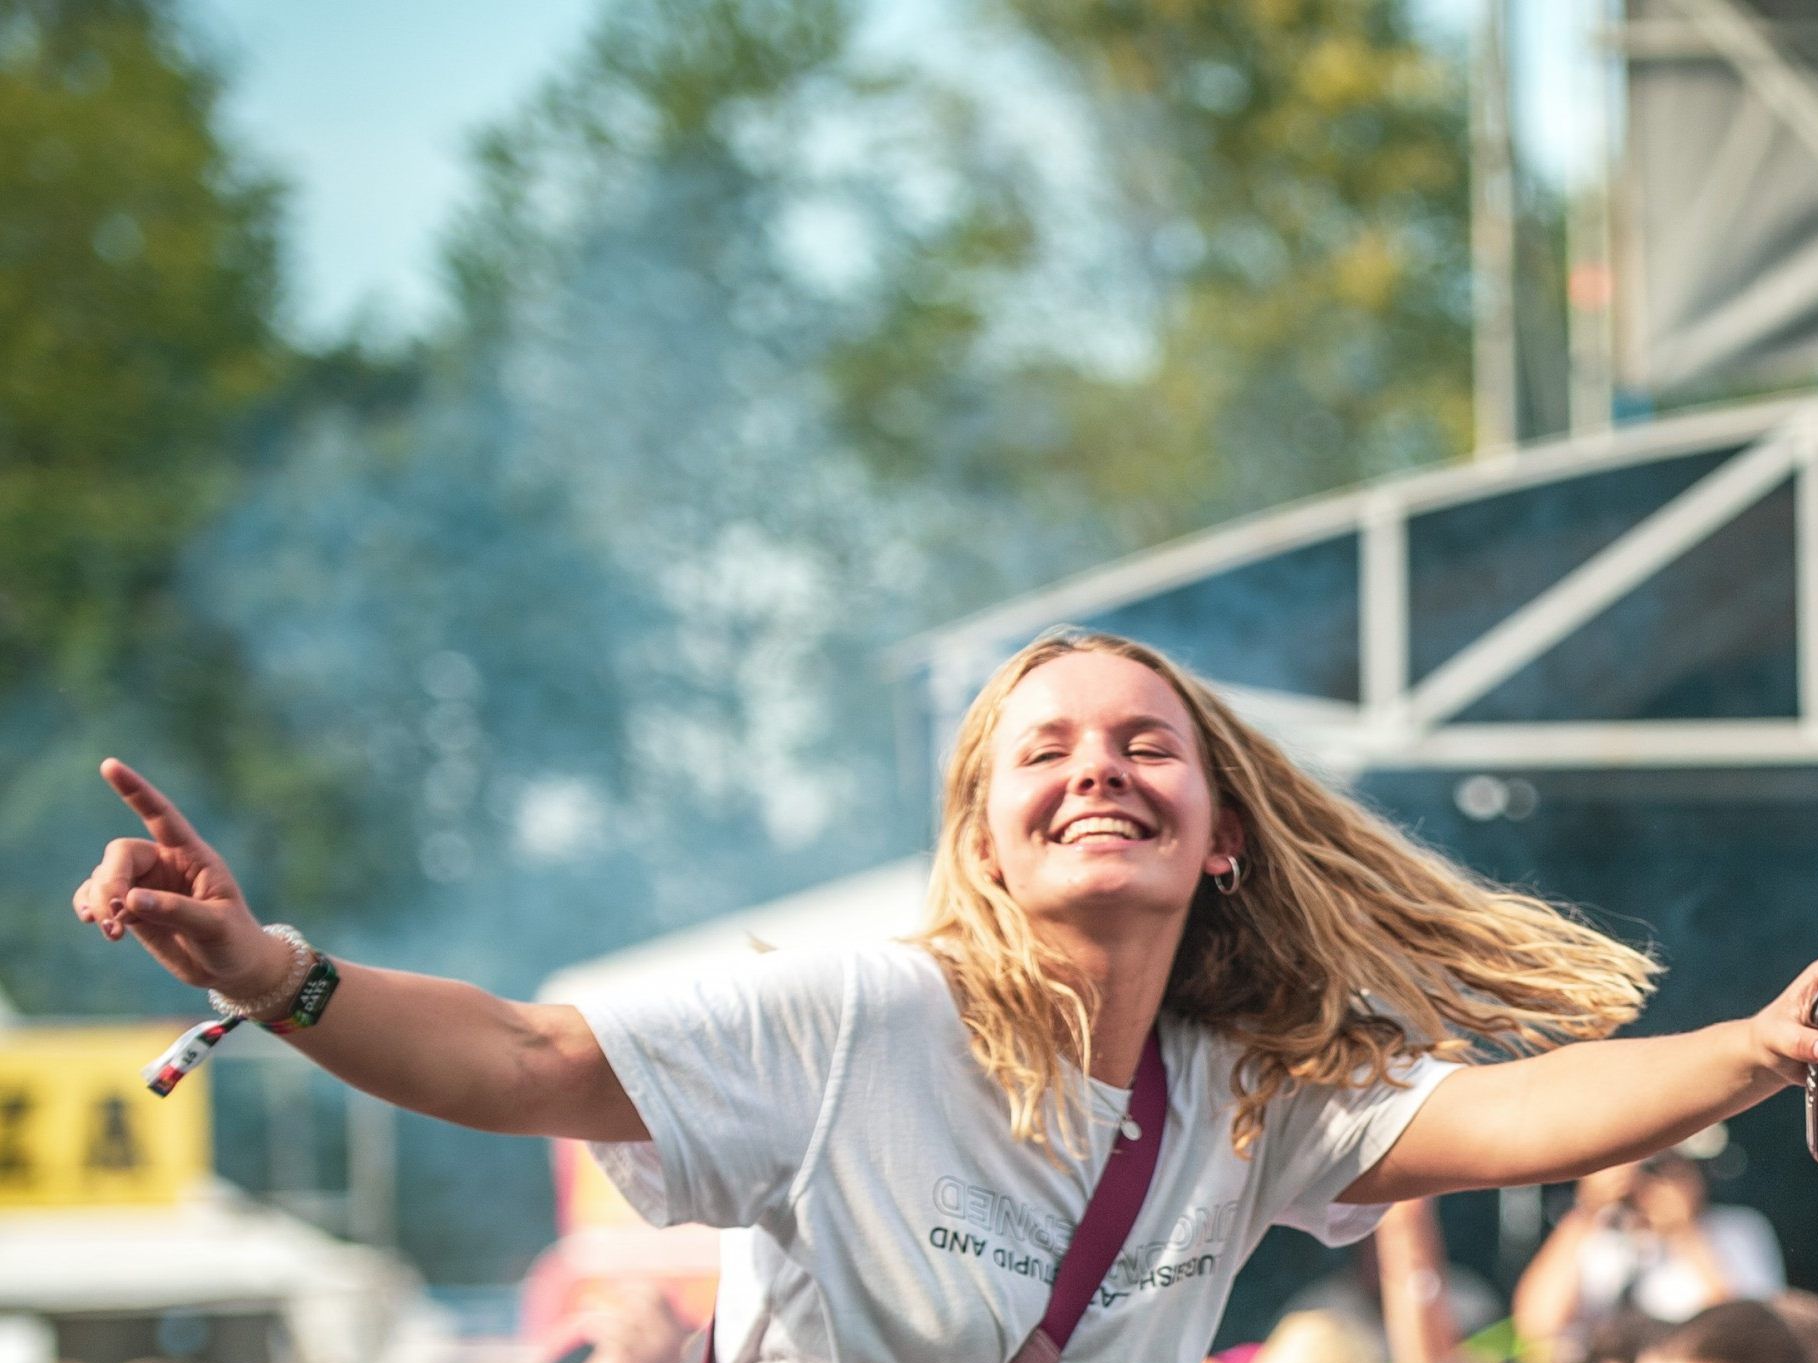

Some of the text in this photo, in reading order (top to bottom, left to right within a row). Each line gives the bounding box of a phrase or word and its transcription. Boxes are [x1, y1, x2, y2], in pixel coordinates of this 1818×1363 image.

[301, 982, 317, 1003] ALL
[304, 979, 327, 1011] DAYS
[929, 1226, 987, 1257] AND
[993, 1248, 1058, 1285] TUPID
